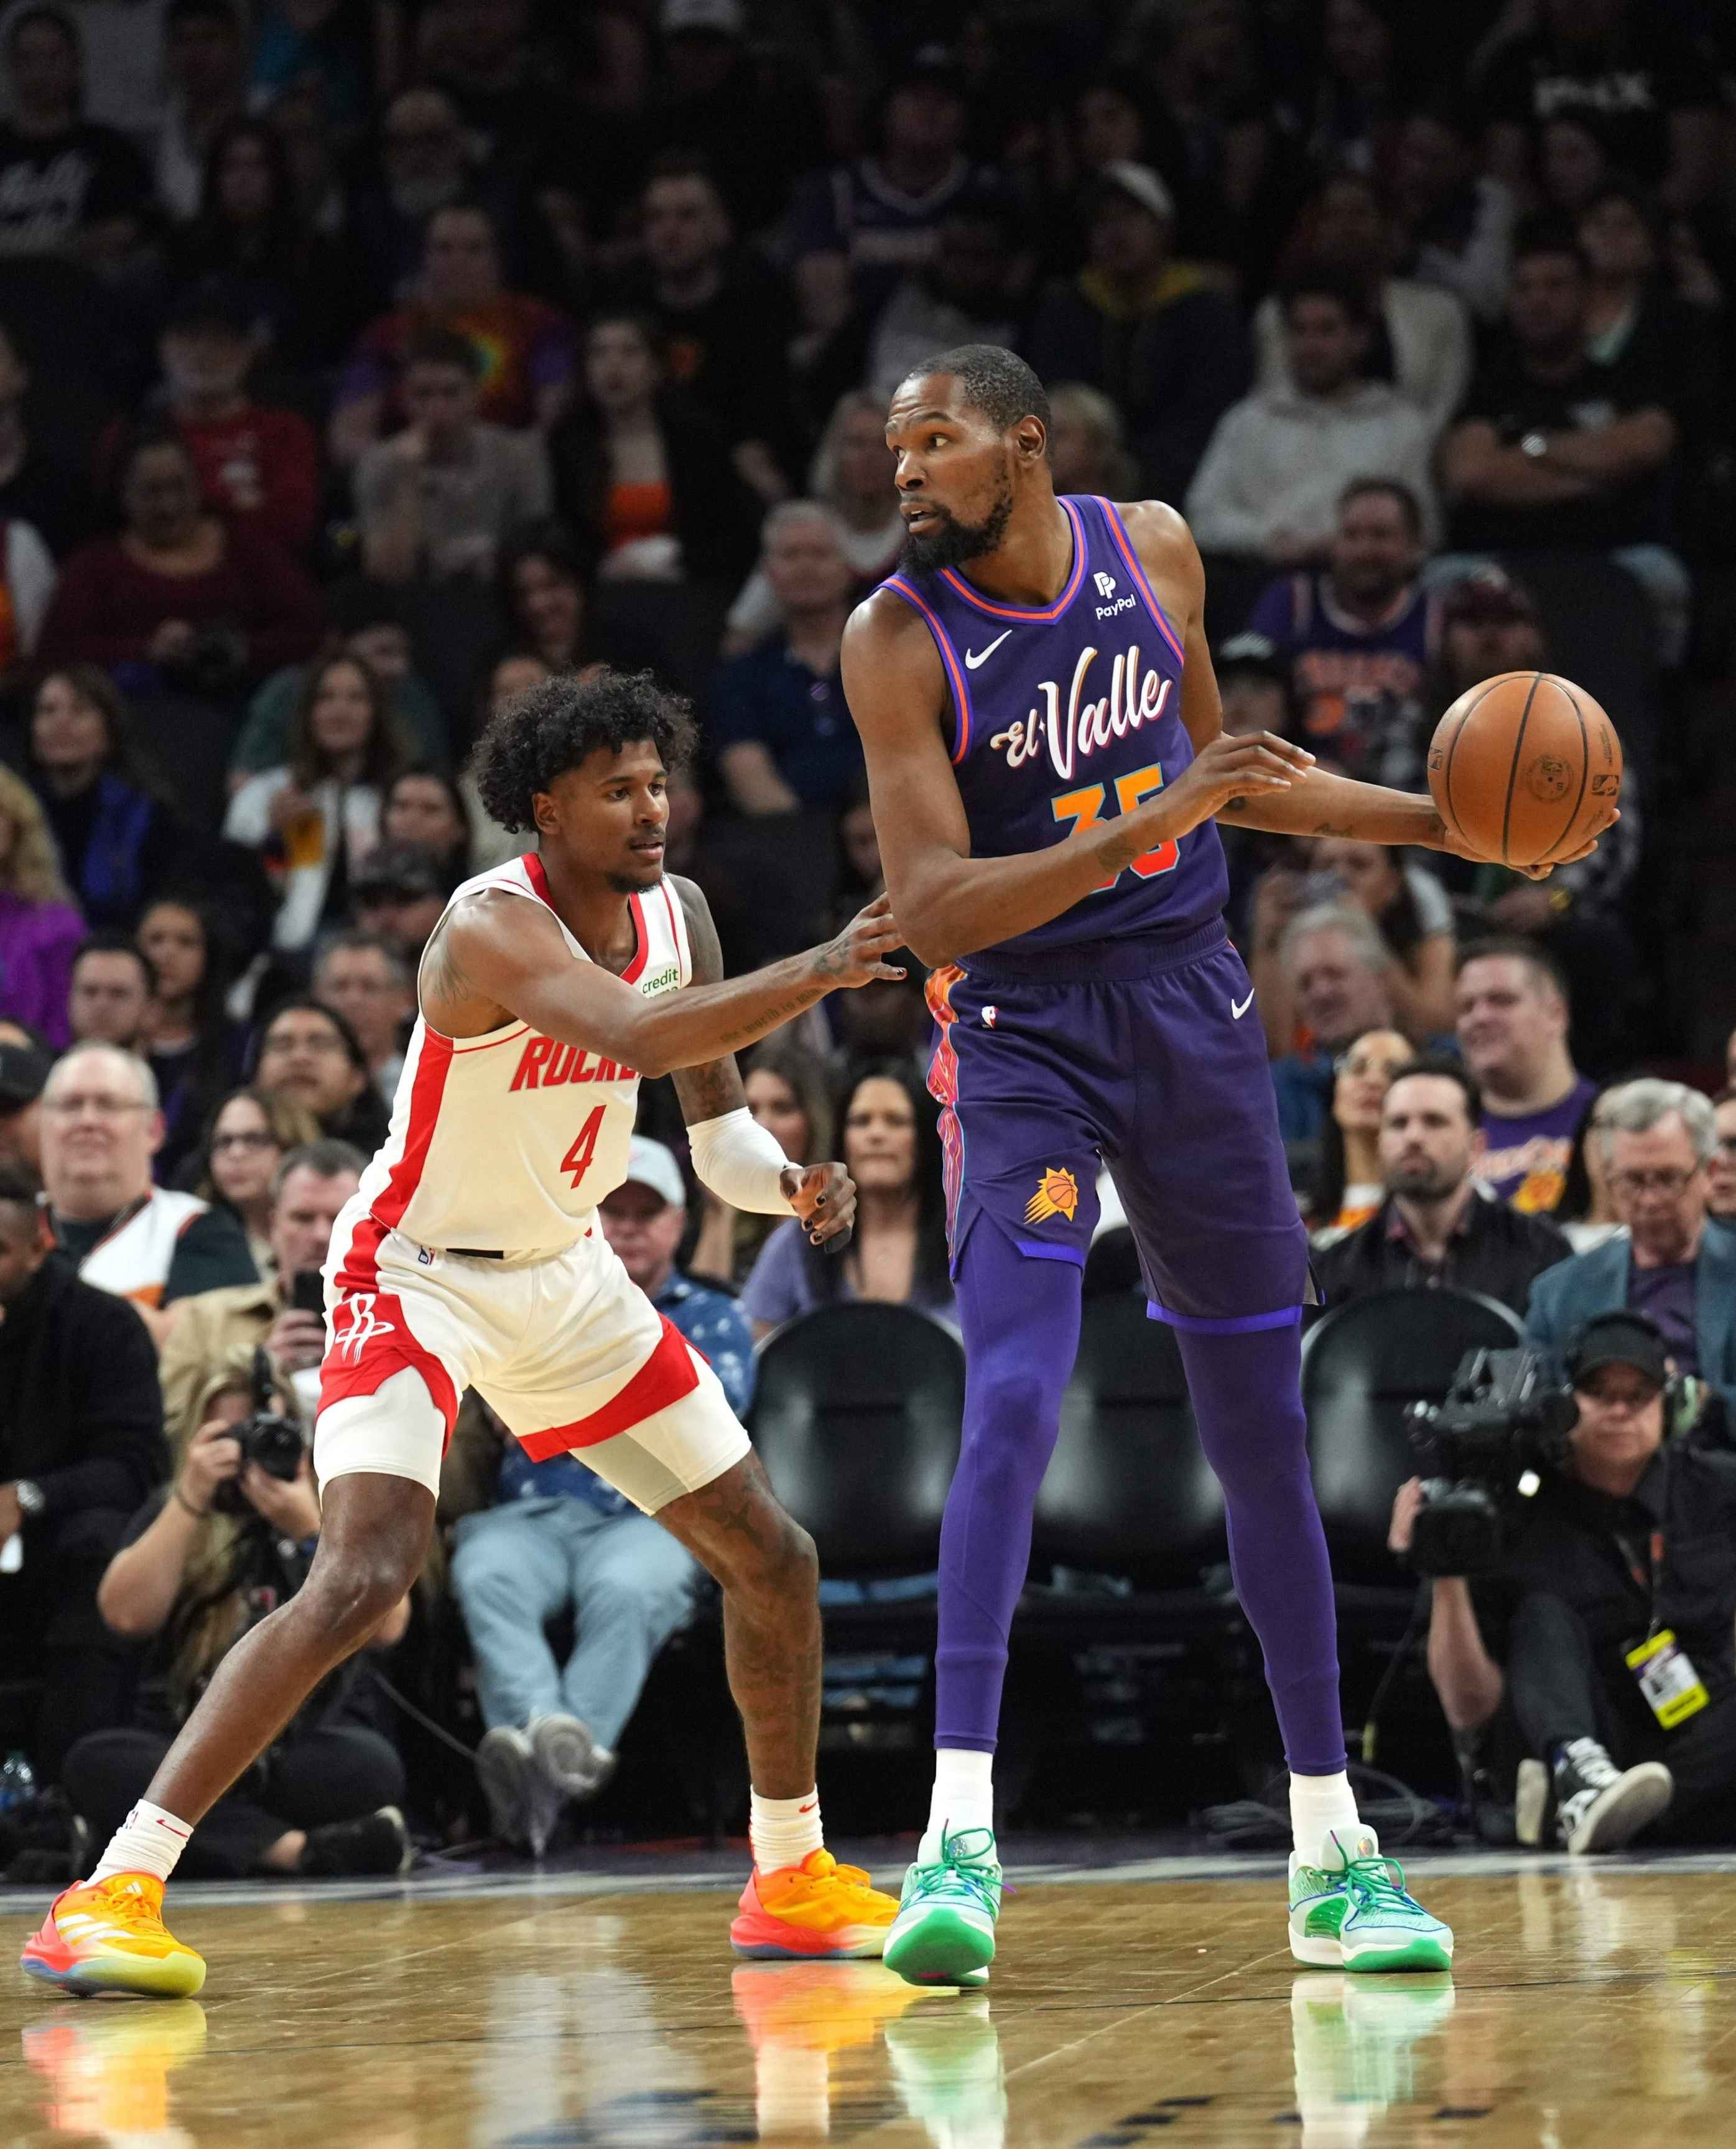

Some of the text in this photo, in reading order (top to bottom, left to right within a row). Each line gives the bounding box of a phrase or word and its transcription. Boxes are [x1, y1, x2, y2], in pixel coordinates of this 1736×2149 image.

[1095, 594, 1136, 620] PayPal
[990, 646, 1172, 781] El Valle
[1051, 762, 1181, 895] 35
[643, 969, 679, 994] credit
[508, 1035, 642, 1093] ROCK
[560, 1104, 607, 1190] 4
